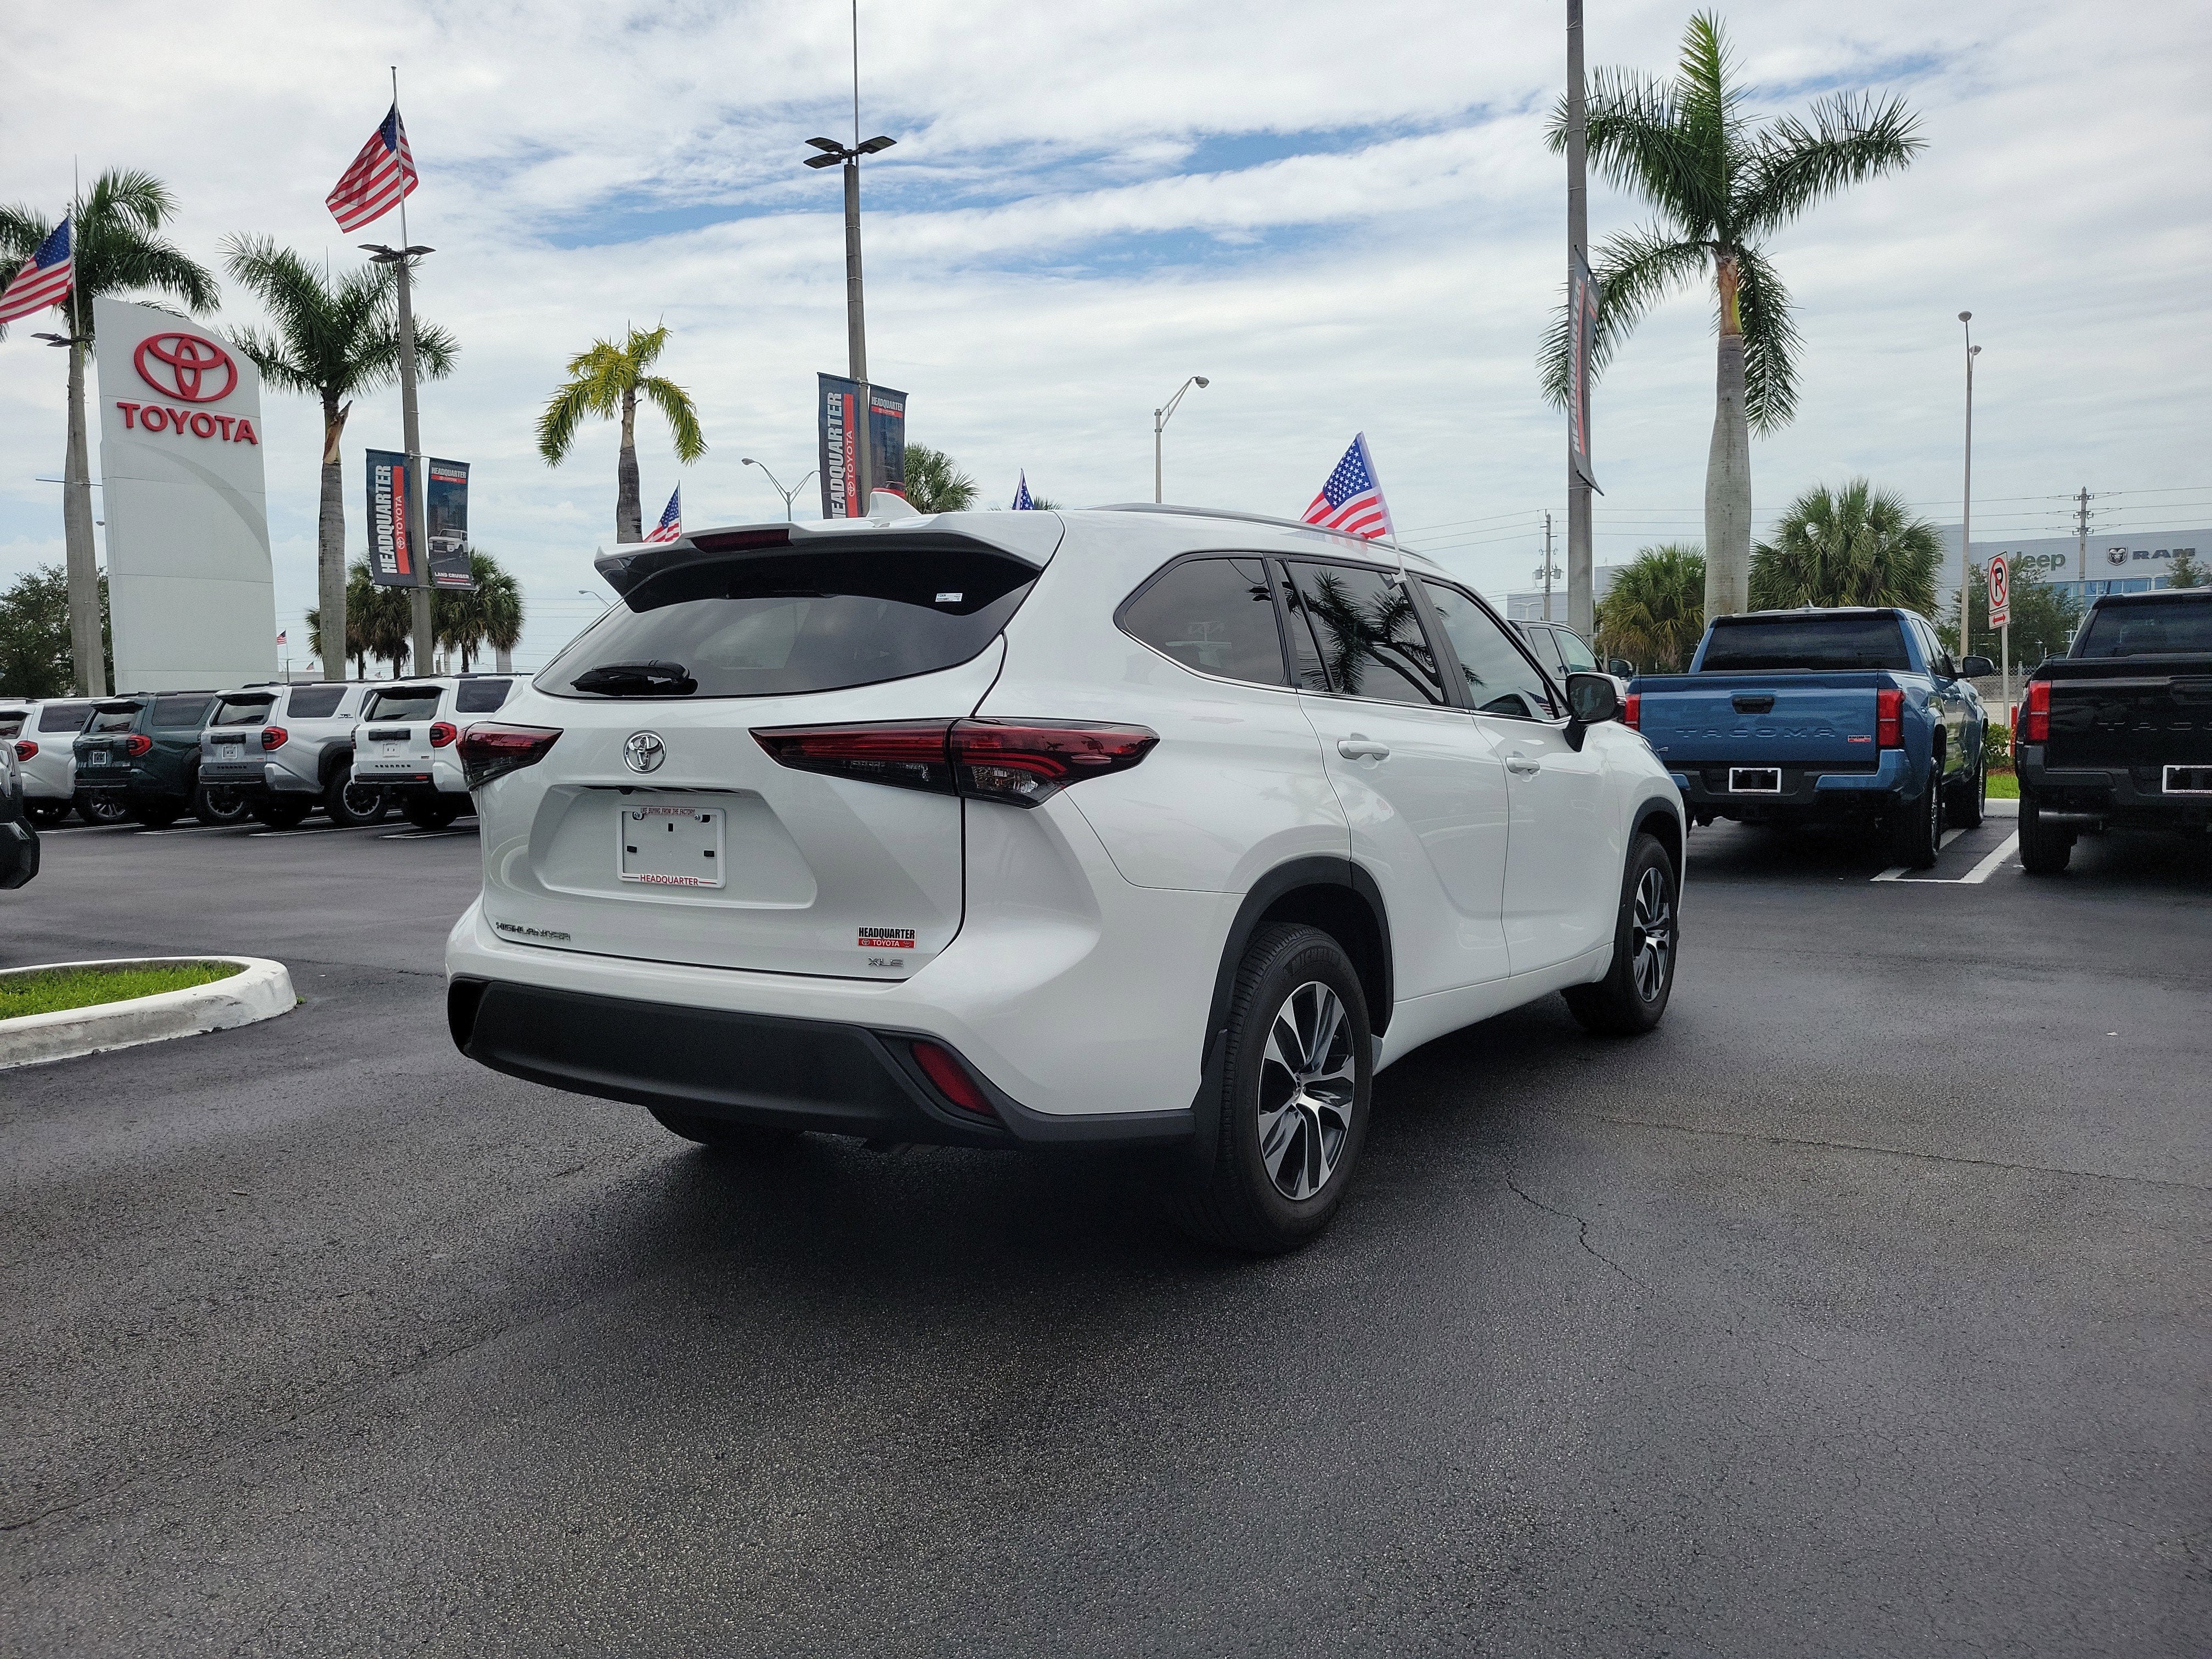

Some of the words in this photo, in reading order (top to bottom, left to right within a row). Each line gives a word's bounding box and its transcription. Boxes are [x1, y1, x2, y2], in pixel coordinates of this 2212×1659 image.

[871, 396, 903, 412] HEADQUARTER
[116, 402, 259, 444] TOYOTA
[846, 430, 854, 480] TOYOTA
[431, 466, 466, 478] HEADQUARTER
[375, 465, 398, 574] HEADQUARTER
[395, 495, 404, 535] TOYOTA
[2132, 548, 2196, 560] RAM
[1675, 728, 1836, 738] TACOMA
[640, 874, 698, 885] HEADQUARTER
[496, 922, 571, 941] HIGHLANDER
[859, 927, 915, 939] HEADQUARTER
[868, 957, 904, 967] XLE
